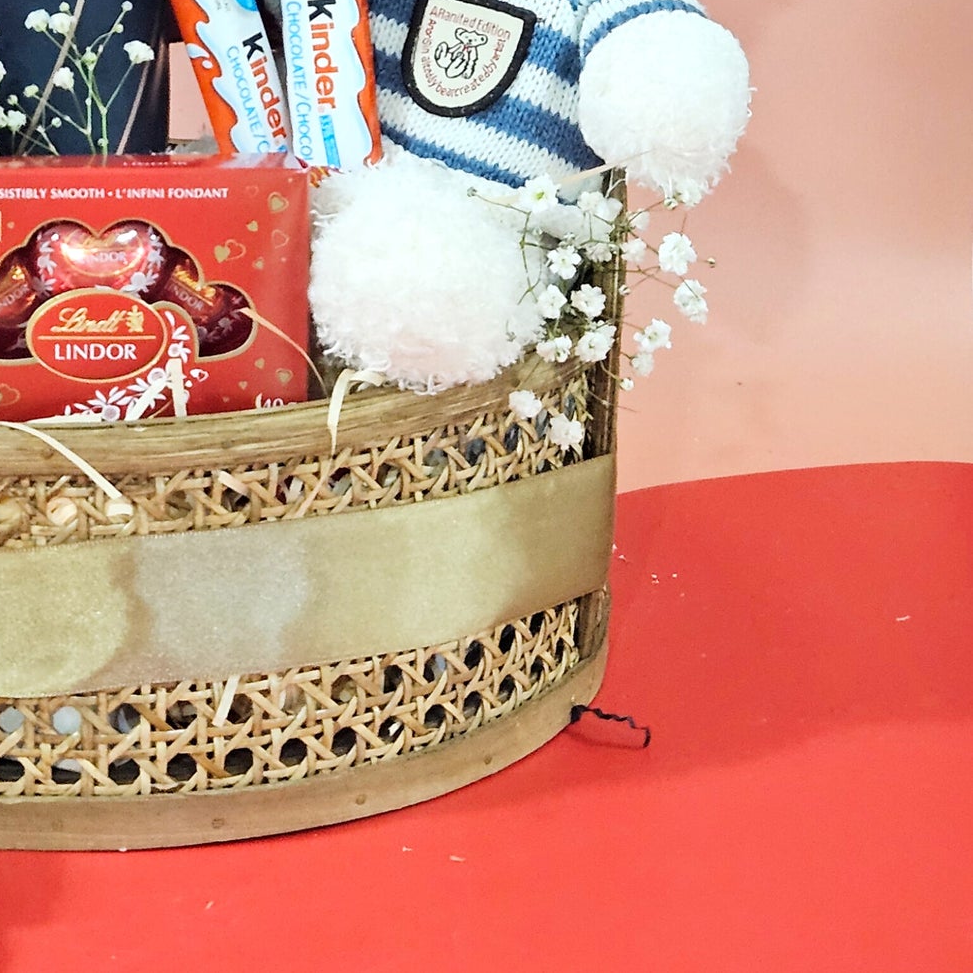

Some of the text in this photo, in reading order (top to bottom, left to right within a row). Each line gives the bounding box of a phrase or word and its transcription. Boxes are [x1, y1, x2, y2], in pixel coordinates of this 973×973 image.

[50, 188, 105, 199] SMOOTH
[168, 187, 229, 199] FONDANT
[50, 307, 127, 333] Lindt
[54, 343, 137, 361] LINDOR
